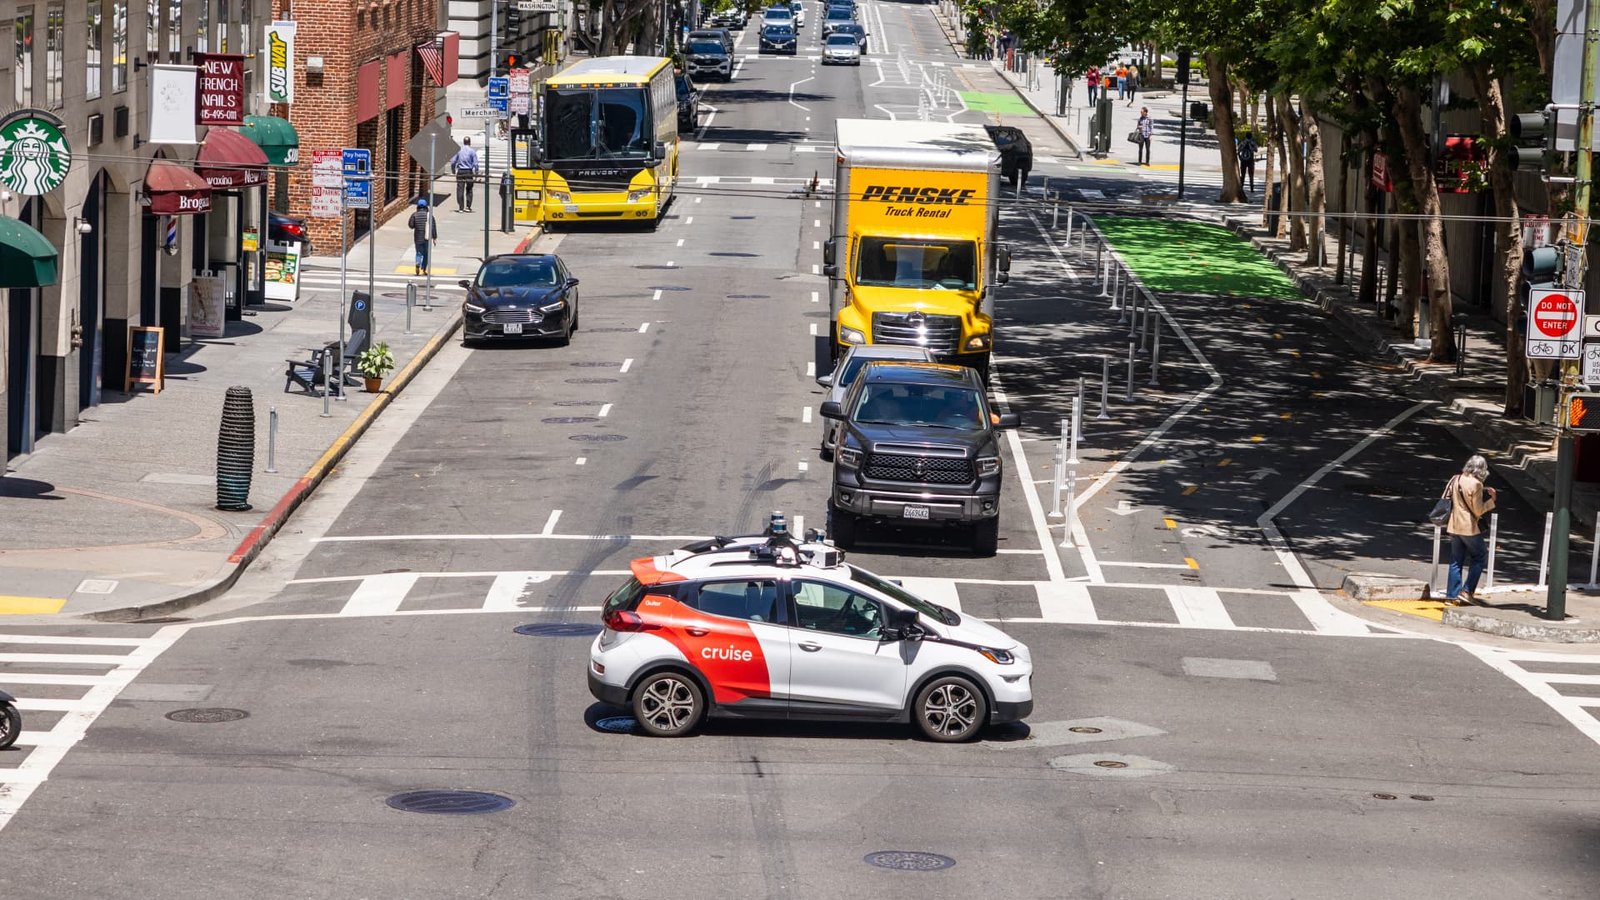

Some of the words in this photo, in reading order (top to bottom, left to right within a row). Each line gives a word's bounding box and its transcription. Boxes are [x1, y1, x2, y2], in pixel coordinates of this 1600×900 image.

[204, 60, 233, 75] NEW
[269, 30, 287, 98] SUBWAY
[199, 77, 238, 91] FRENCH
[201, 93, 236, 107] NAILS
[343, 151, 354, 159] Pay
[244, 169, 259, 184] New
[312, 187, 321, 196] NO
[861, 185, 977, 206] PENSKE
[885, 206, 914, 217] Truck
[915, 207, 952, 219] Rental
[1556, 302, 1572, 310] NOT
[1542, 321, 1567, 329] ENTER
[1562, 344, 1575, 354] OK
[701, 645, 753, 661] cruise
